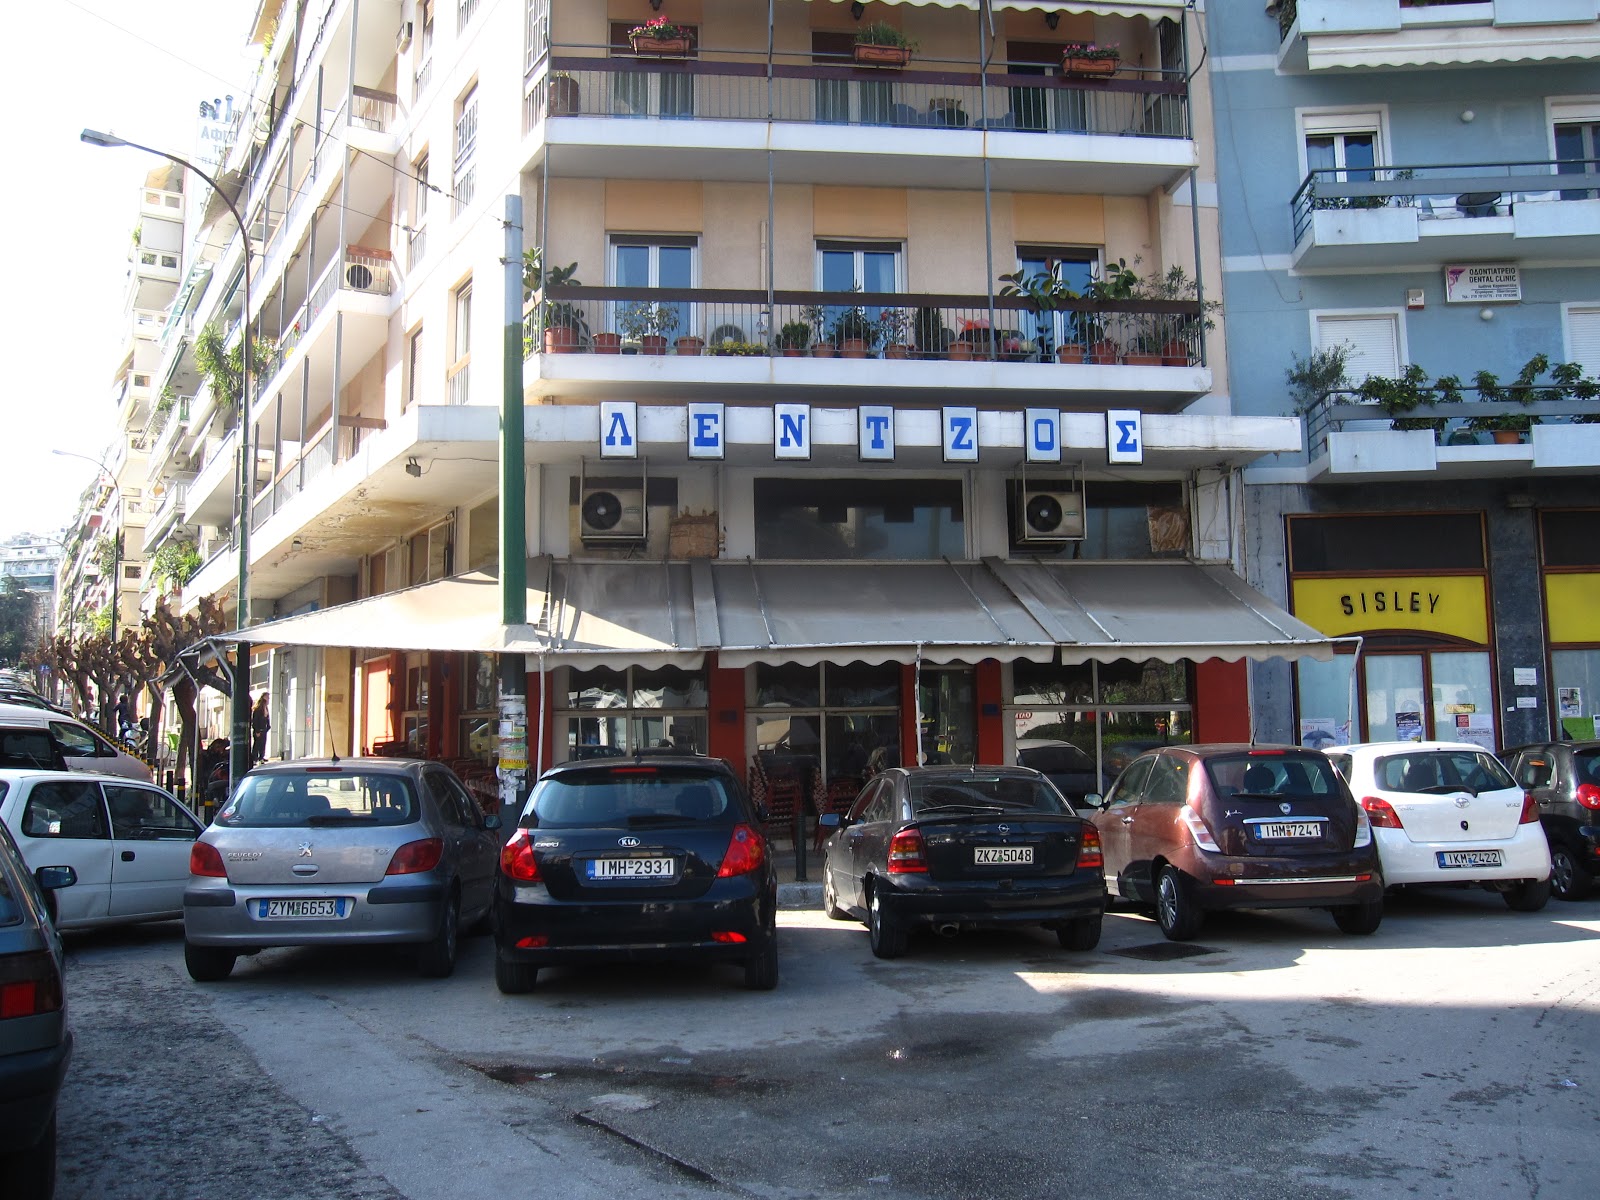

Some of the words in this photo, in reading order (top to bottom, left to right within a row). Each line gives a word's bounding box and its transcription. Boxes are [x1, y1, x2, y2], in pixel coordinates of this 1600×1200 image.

[1469, 267, 1516, 276] ΟΔΟΝΤΙΑΤΡΕΙΟ
[605, 412, 1142, 452] ΛΕΝΤΖΟΣ
[1340, 591, 1440, 615] SISLEY
[621, 838, 637, 846] KIA
